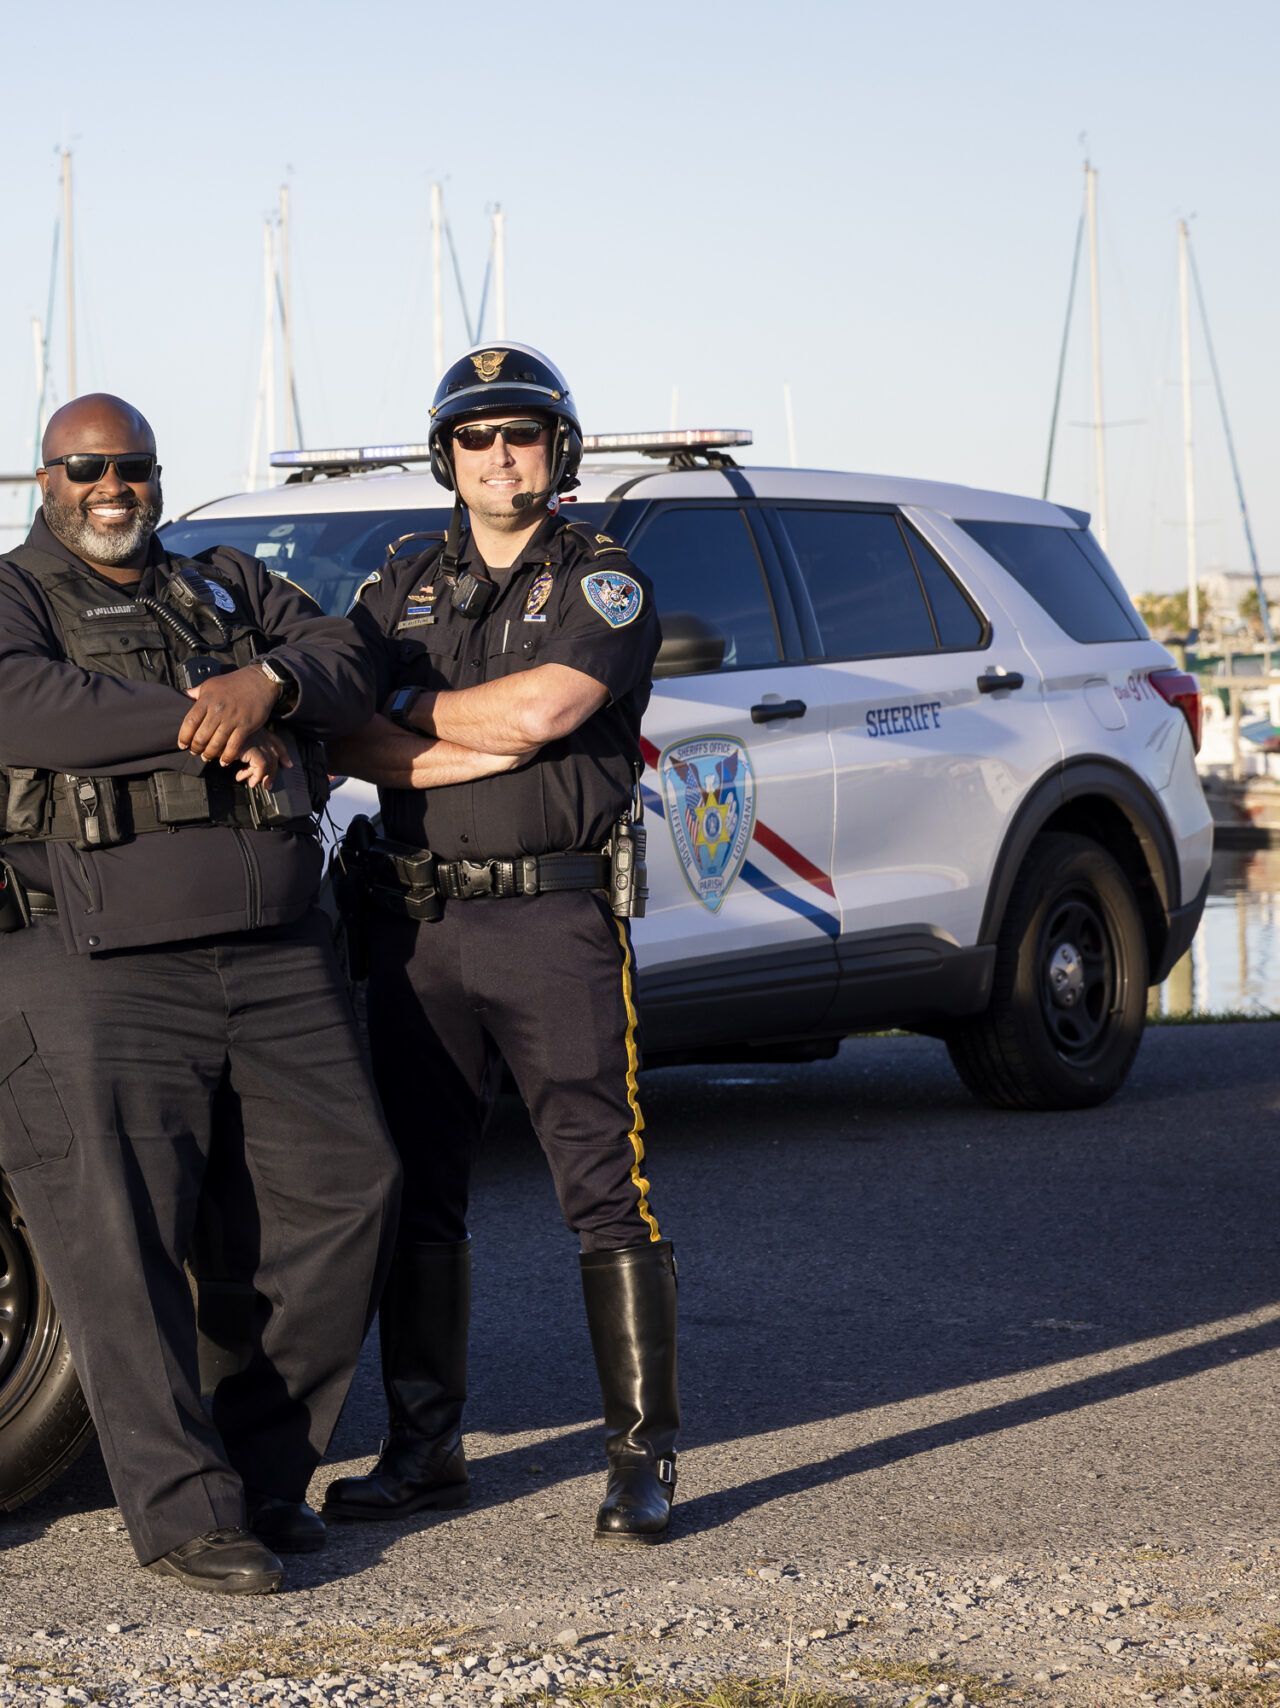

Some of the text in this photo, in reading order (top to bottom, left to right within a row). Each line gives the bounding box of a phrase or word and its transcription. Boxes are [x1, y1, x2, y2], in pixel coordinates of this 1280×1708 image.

[866, 701, 941, 738] SHERIFF
[709, 742, 731, 754] OFFICE
[670, 803, 694, 869] JEFFERSON
[732, 796, 752, 862] LOUISIANA
[699, 878, 723, 891] PARISH
